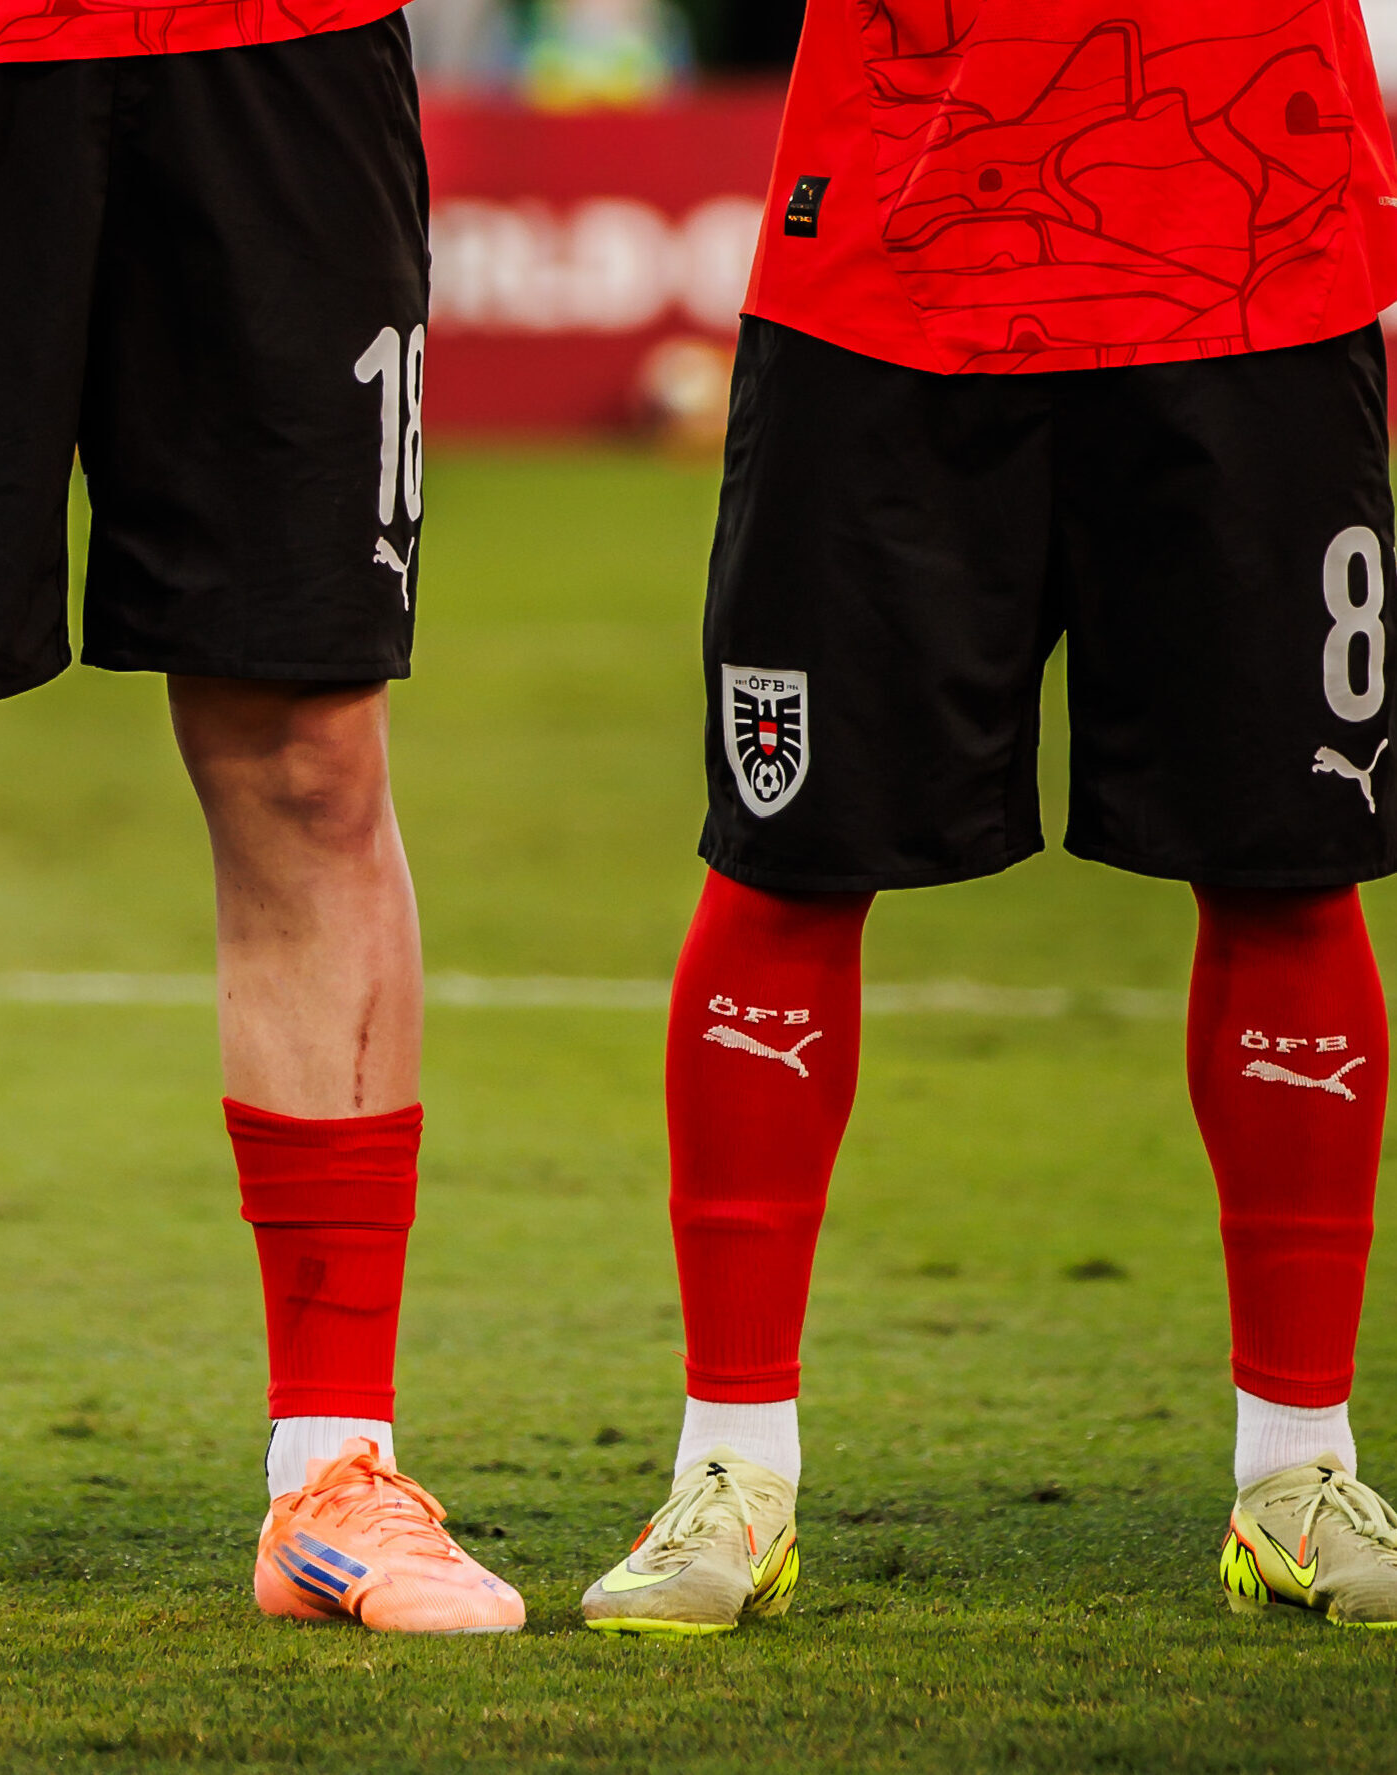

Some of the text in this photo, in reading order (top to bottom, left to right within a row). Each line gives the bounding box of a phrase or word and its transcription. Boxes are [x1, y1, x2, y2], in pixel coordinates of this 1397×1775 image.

[354, 323, 425, 526] 18
[1323, 526, 1385, 723] 8
[748, 675, 785, 692] ÖFB
[708, 994, 810, 1024] ÖFB
[1241, 1029, 1349, 1054] ÖFB
